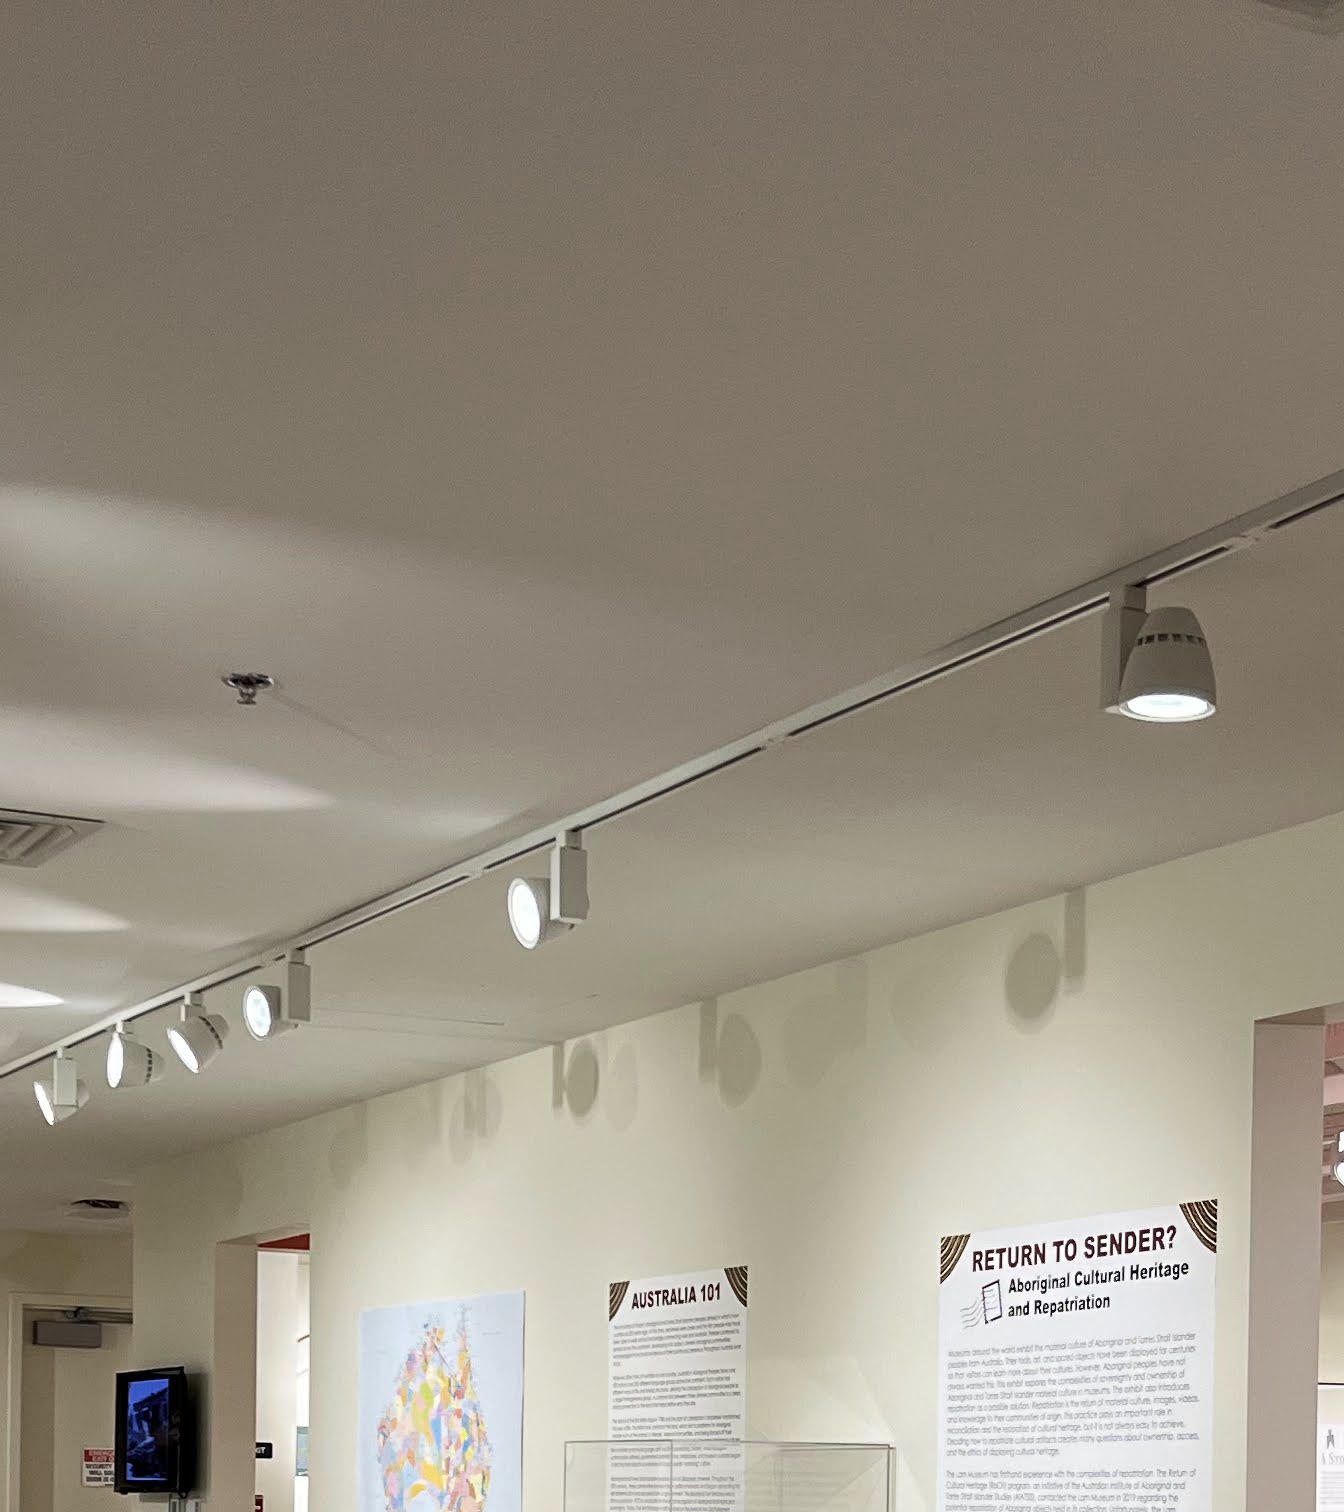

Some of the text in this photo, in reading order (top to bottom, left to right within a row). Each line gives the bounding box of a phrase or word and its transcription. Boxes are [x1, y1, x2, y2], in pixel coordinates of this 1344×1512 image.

[972, 1225, 1177, 1272] RETURN TO SENDER?
[1008, 1262, 1189, 1294] Aboriginal Cultural Heritage
[632, 1282, 720, 1309] AUSTRALIA 101
[1008, 1295, 1110, 1317] and Repatriation
